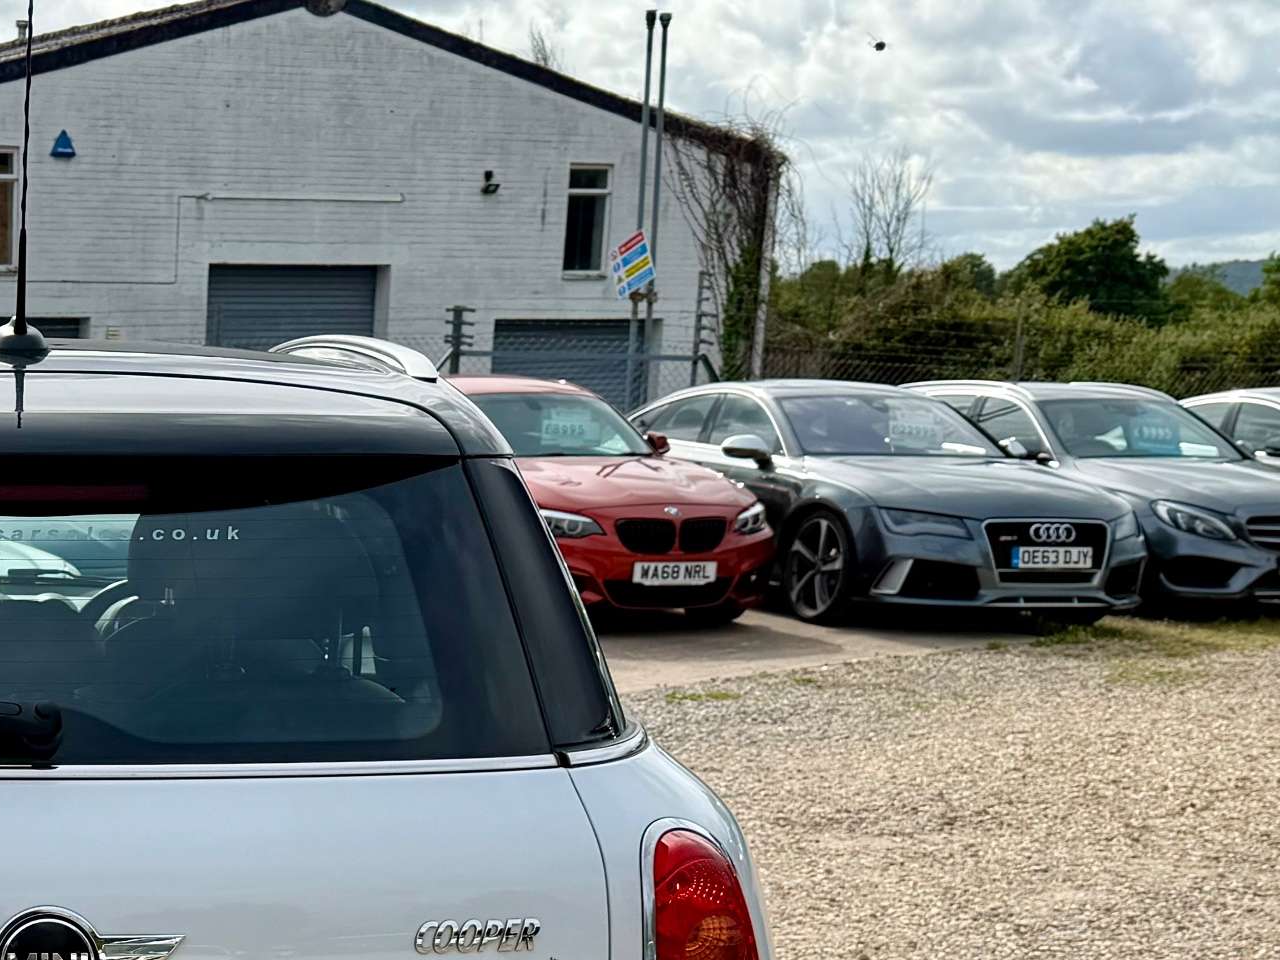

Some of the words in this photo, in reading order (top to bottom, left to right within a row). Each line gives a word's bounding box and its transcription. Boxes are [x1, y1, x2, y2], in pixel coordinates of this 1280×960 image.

[1022, 550, 1059, 564] OE63
[1064, 550, 1089, 564] DJY
[641, 564, 680, 579] WA68
[684, 564, 710, 579] NRL
[414, 918, 541, 955] COOPER
